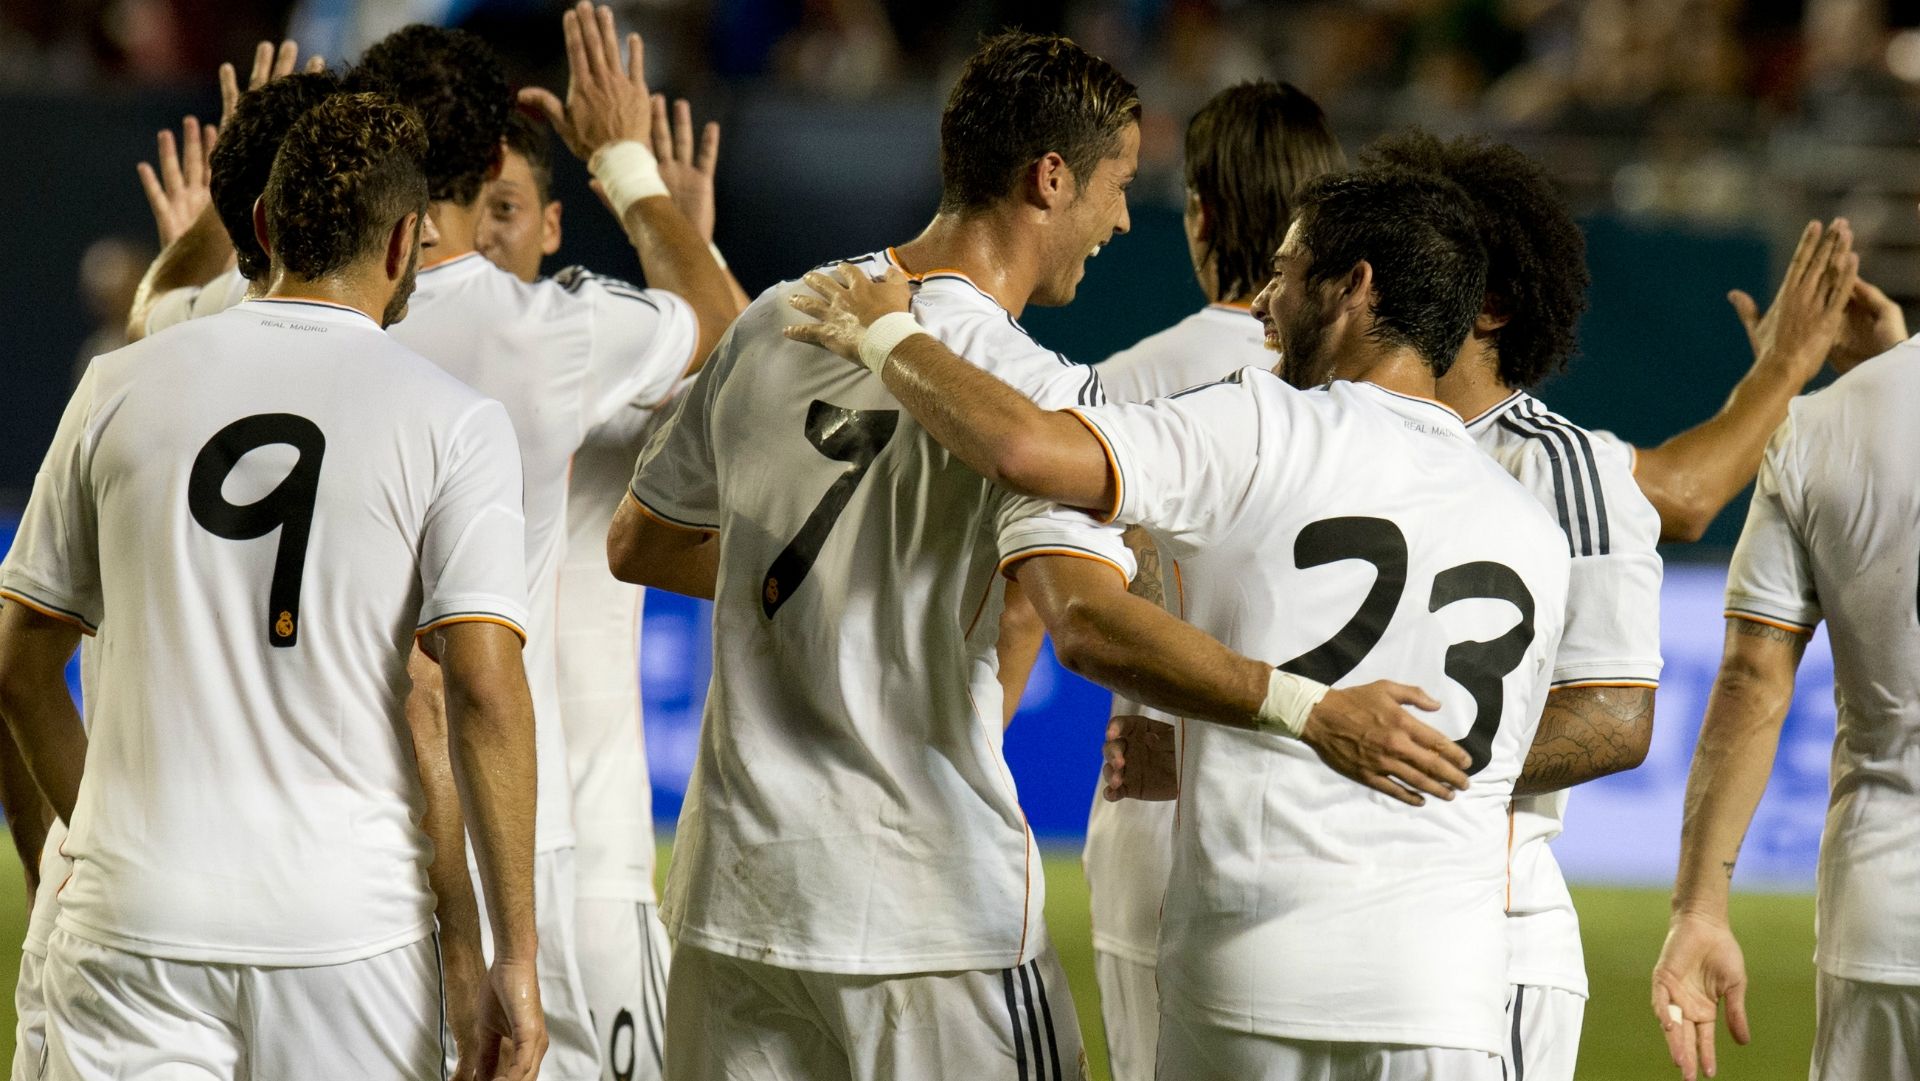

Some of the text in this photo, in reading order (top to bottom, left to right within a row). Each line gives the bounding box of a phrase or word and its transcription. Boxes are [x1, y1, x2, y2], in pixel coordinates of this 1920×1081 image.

[260, 319, 328, 333] REAL MADRID
[1403, 420, 1428, 433] REAL
[188, 413, 326, 648] 9
[762, 399, 900, 620] 7
[1275, 516, 1536, 777] 23
